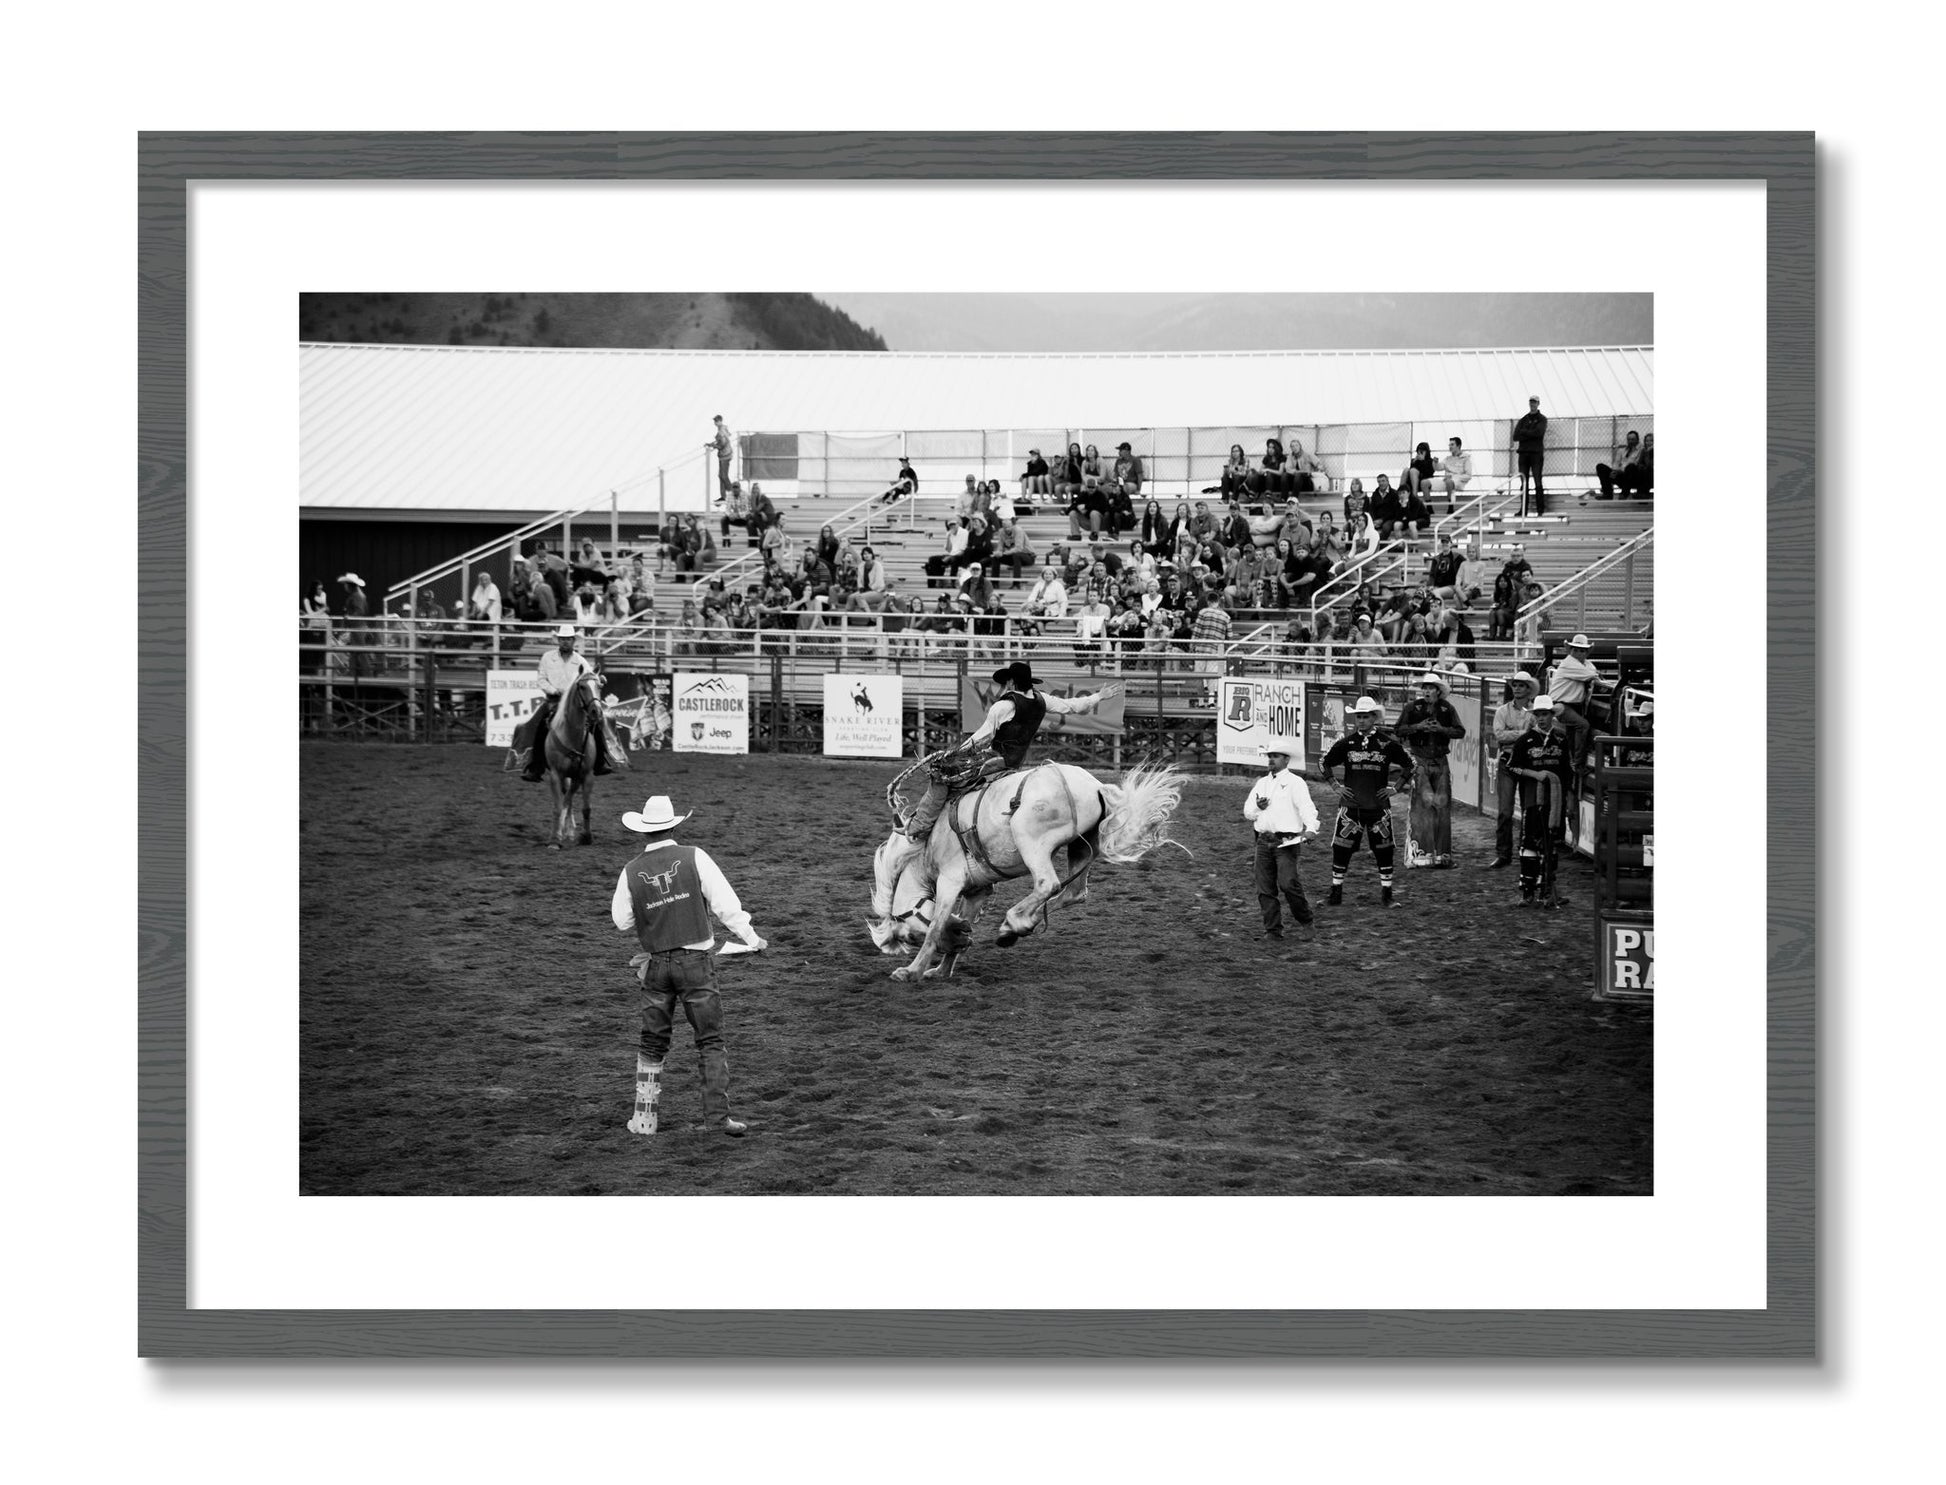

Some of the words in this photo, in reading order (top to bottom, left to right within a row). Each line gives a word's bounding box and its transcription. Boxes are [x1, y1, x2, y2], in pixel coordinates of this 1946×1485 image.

[490, 680, 507, 689] TETON
[509, 680, 527, 689] TRASH
[1233, 686, 1250, 696] BIG
[1255, 684, 1300, 705] RANCH
[678, 698, 744, 712] CASTLEROCK
[1228, 695, 1252, 722] R
[824, 716, 860, 725] SNAKE
[867, 717, 900, 725] RIVER
[1256, 711, 1268, 723] AND
[1269, 705, 1301, 737] HOME
[709, 727, 732, 739] Jeep
[674, 892, 690, 900] Rodeo
